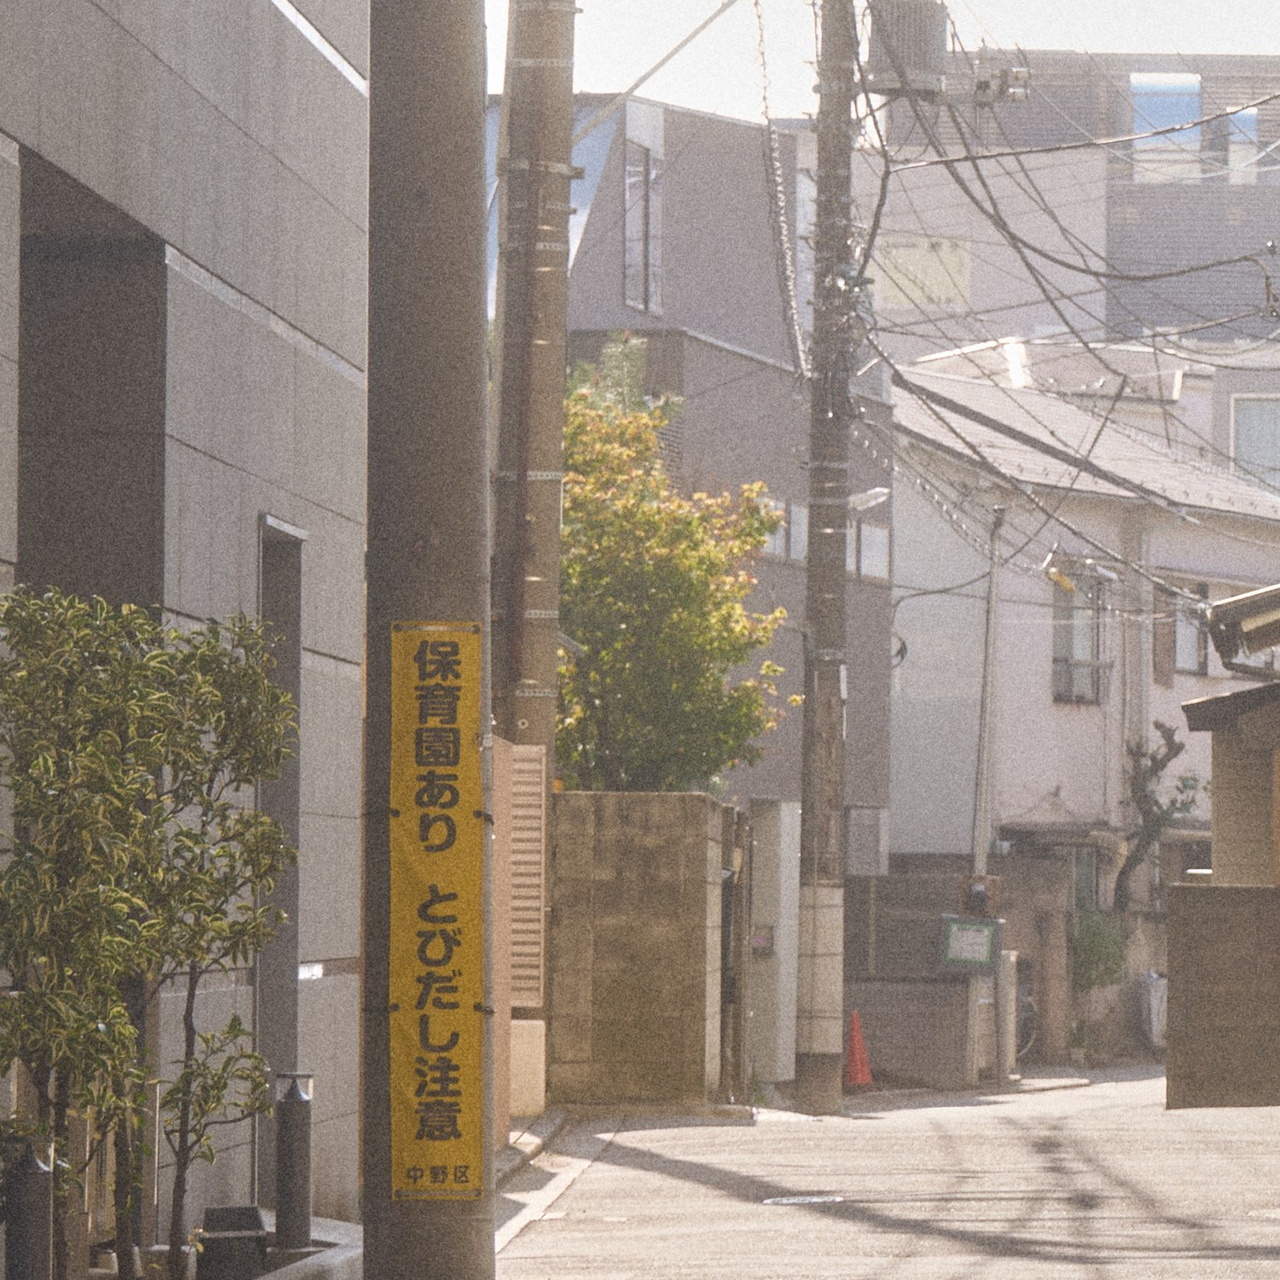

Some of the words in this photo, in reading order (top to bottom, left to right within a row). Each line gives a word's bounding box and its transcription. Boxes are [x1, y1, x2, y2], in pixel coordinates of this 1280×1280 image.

[413, 639, 462, 853] 保育園あり
[415, 883, 463, 1142] とびだし注意
[405, 1164, 470, 1185] 中野区
